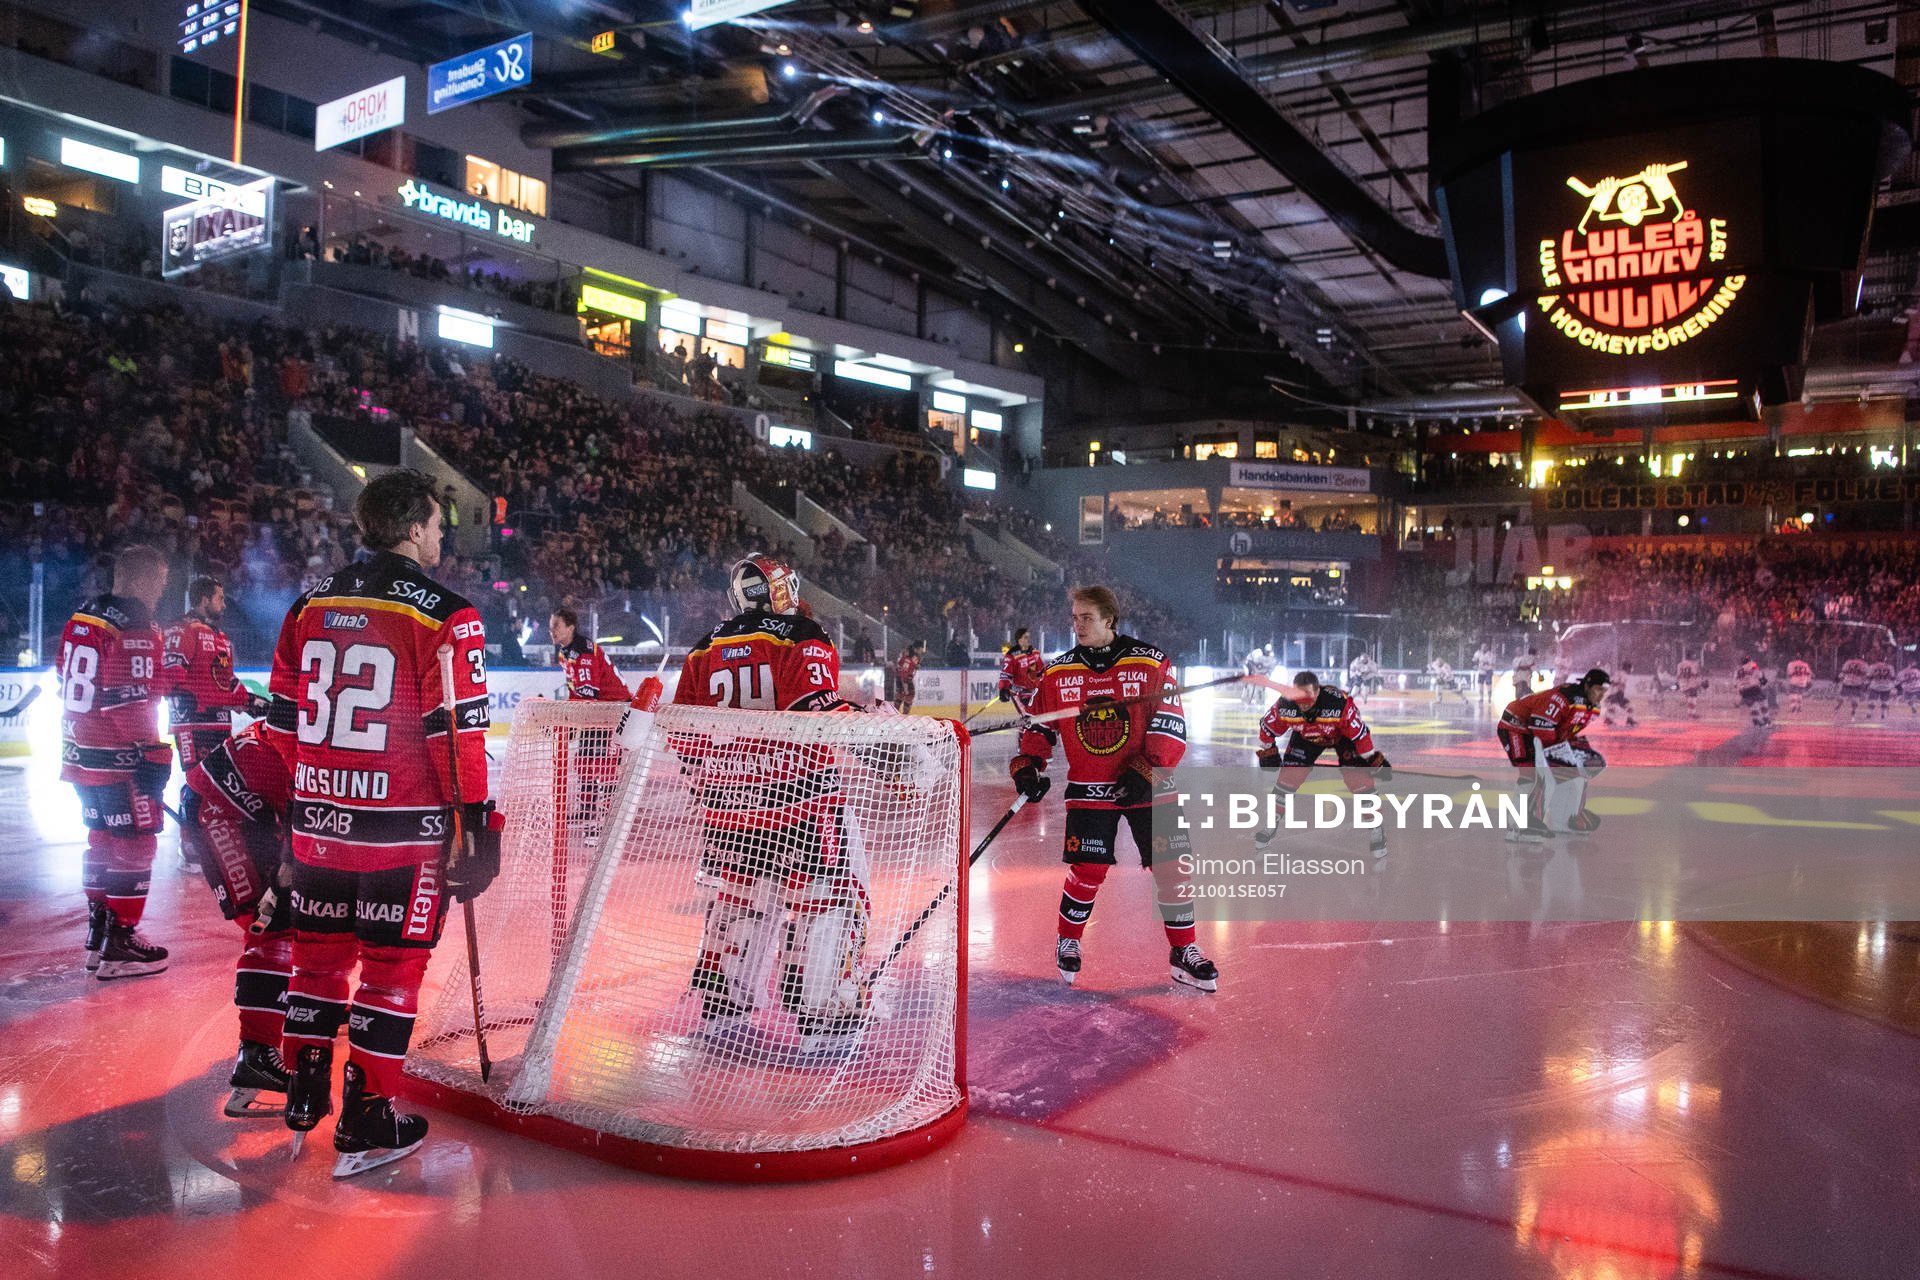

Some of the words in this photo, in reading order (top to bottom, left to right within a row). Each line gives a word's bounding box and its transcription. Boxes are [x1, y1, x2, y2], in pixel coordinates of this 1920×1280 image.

[419, 183, 490, 230] bravida
[497, 208, 535, 242] bar
[1562, 210, 1704, 260] LULEÅ
[1551, 274, 1746, 356] HOCKEYFÖRENING
[1709, 217, 1728, 263] 1977
[1238, 469, 1328, 485] Handelsbanken
[1547, 486, 1658, 511] SOLENS
[1665, 482, 1745, 508] STAD
[387, 580, 442, 611] SSAB
[323, 611, 370, 630] Vinab
[1130, 646, 1164, 661] SSAB
[467, 647, 487, 685] 3
[807, 662, 836, 687] 34
[1059, 675, 1084, 687] LKAB
[296, 639, 396, 753] 32
[971, 683, 1000, 701] NIEM
[1087, 687, 1115, 697] SCANIA
[1320, 709, 1341, 718] SSAB
[1544, 703, 1560, 718] 31
[615, 708, 631, 736] SHL
[223, 771, 264, 814] SSAB
[1163, 775, 1175, 790] SS
[304, 806, 353, 835] SSAB
[419, 814, 448, 837] SS
[1081, 846, 1107, 854] Energi
[299, 896, 349, 919] LKAB
[360, 902, 405, 923] LKAB
[1067, 908, 1088, 919] NEX
[286, 1005, 321, 1023] NEX
[350, 1014, 375, 1032] EX
